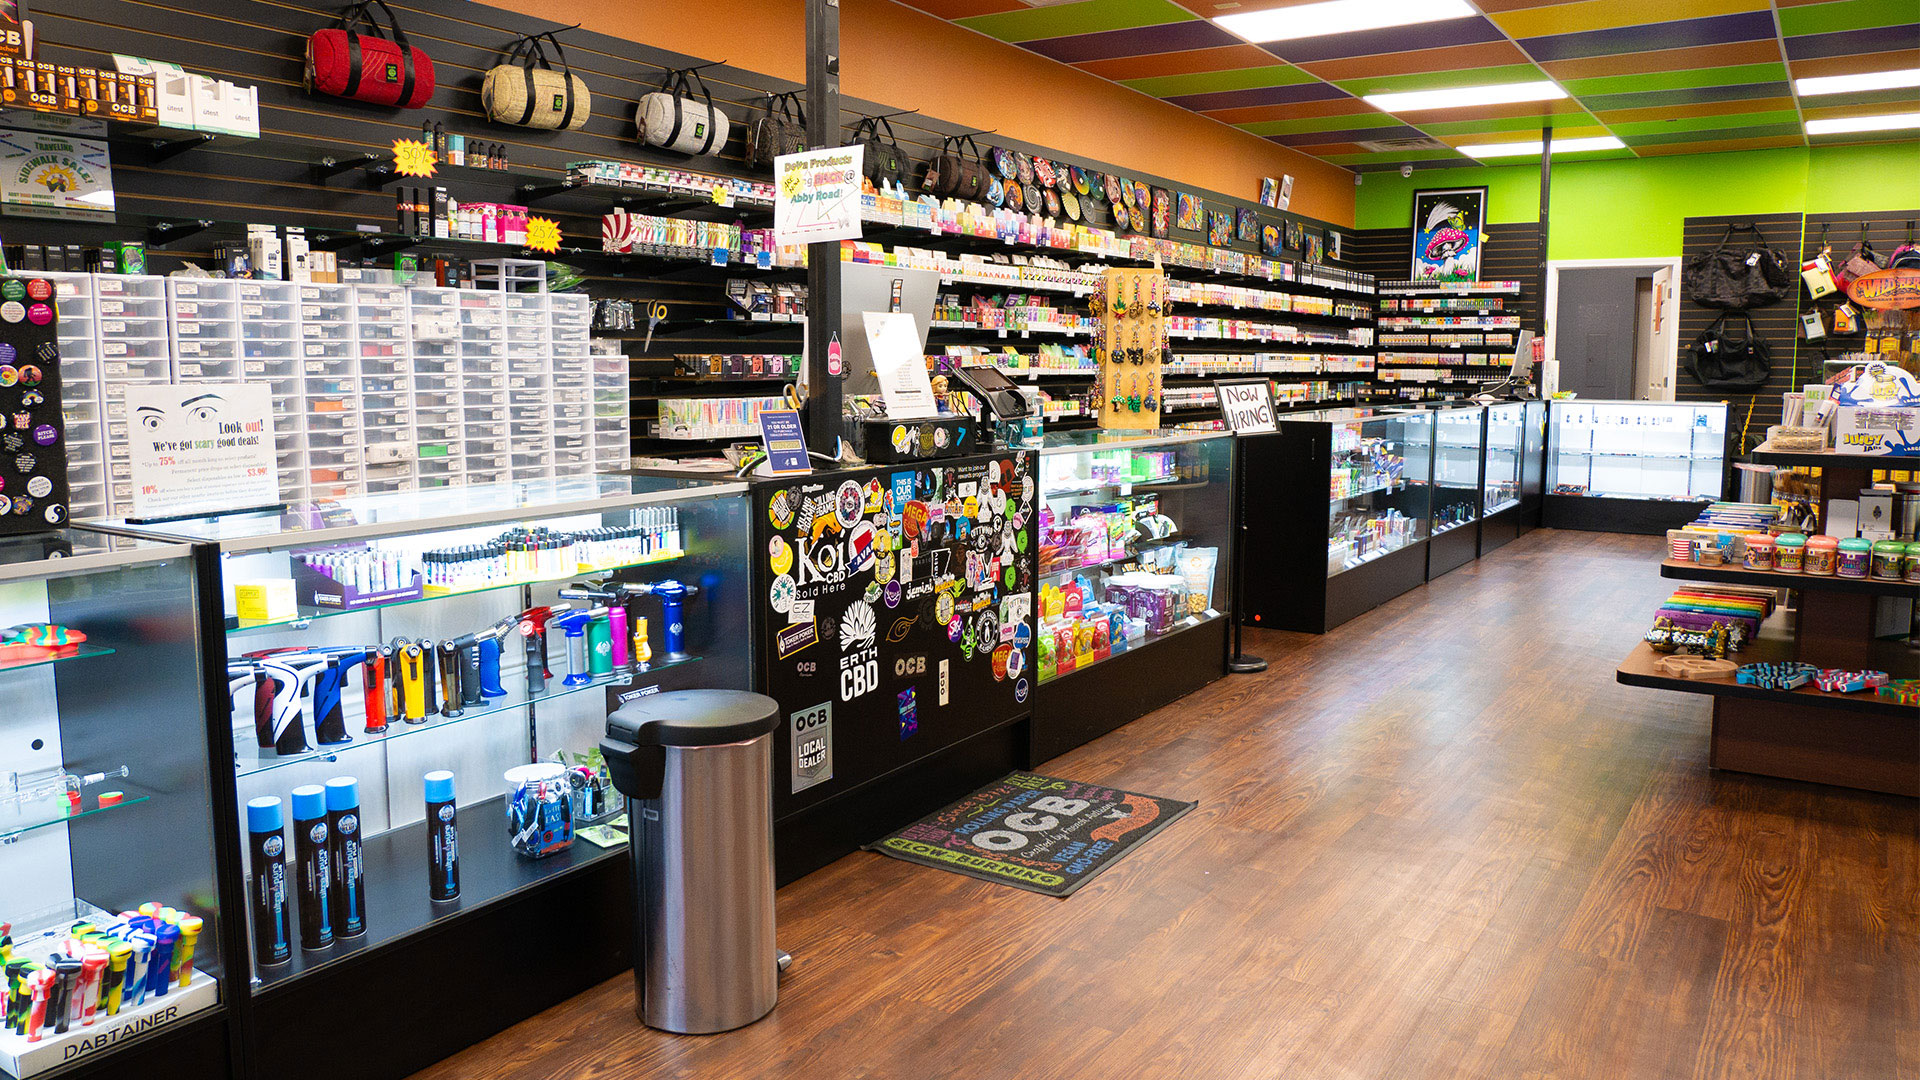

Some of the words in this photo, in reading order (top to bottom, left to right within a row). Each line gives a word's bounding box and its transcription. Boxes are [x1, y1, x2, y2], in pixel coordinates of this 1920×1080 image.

[16, 59, 35, 68] OCB
[37, 63, 56, 71] OCB
[58, 66, 76, 75] OCB
[78, 68, 97, 77] OCB
[99, 71, 117, 80] OCB
[118, 74, 136, 82] OCB
[138, 77, 155, 85] OCB
[30, 92, 57, 105] OCB
[111, 103, 137, 115] OCB
[34, 141, 74, 152] TRAVELING
[19, 154, 59, 184] SIDEWALK
[62, 157, 94, 184] SALE!
[810, 155, 853, 169] Products
[790, 189, 815, 204] Abby
[533, 225, 555, 240] 25%
[1857, 279, 1897, 298] WILD
[1226, 386, 1259, 405] NOW
[1805, 390, 1820, 400] TAKE
[1225, 396, 1275, 430] HIRING!
[218, 421, 243, 435] Look
[245, 418, 264, 433] out!
[152, 440, 178, 452] We've
[179, 440, 193, 451] got
[194, 439, 214, 450] scary
[216, 437, 236, 448] good
[238, 435, 259, 446] deals!
[956, 426, 967, 447] 7
[1843, 433, 1886, 446] JUICY
[158, 456, 176, 466] 75%
[247, 466, 268, 477] $3.99!
[142, 485, 158, 495] 10%
[895, 478, 907, 486] THIS
[907, 477, 912, 485] IS
[895, 484, 912, 496] OUR
[903, 502, 928, 523] MEGA
[795, 528, 848, 587] Koi
[826, 570, 846, 584] CBD
[796, 585, 819, 600] Sold
[822, 582, 846, 595] Here
[793, 602, 811, 614] EZ
[840, 646, 878, 670] ERTH
[895, 656, 926, 677] OCB
[797, 661, 817, 673] OCB
[840, 659, 879, 702] CBD
[795, 708, 828, 732] OCB
[798, 737, 826, 758] LOCAL
[798, 749, 826, 769] DEALER
[953, 807, 1009, 835] ROLLING
[1002, 789, 1043, 809] PAPER
[971, 795, 1091, 851] OCB
[346, 839, 354, 864] pure
[1051, 841, 1088, 863] VEGAN
[1065, 840, 1114, 875] GMO-FREE
[889, 838, 1064, 886] SLOW-BURNING
[272, 862, 280, 887] pure
[274, 891, 282, 914] ultra
[63, 1006, 179, 1060] DABTAINER
